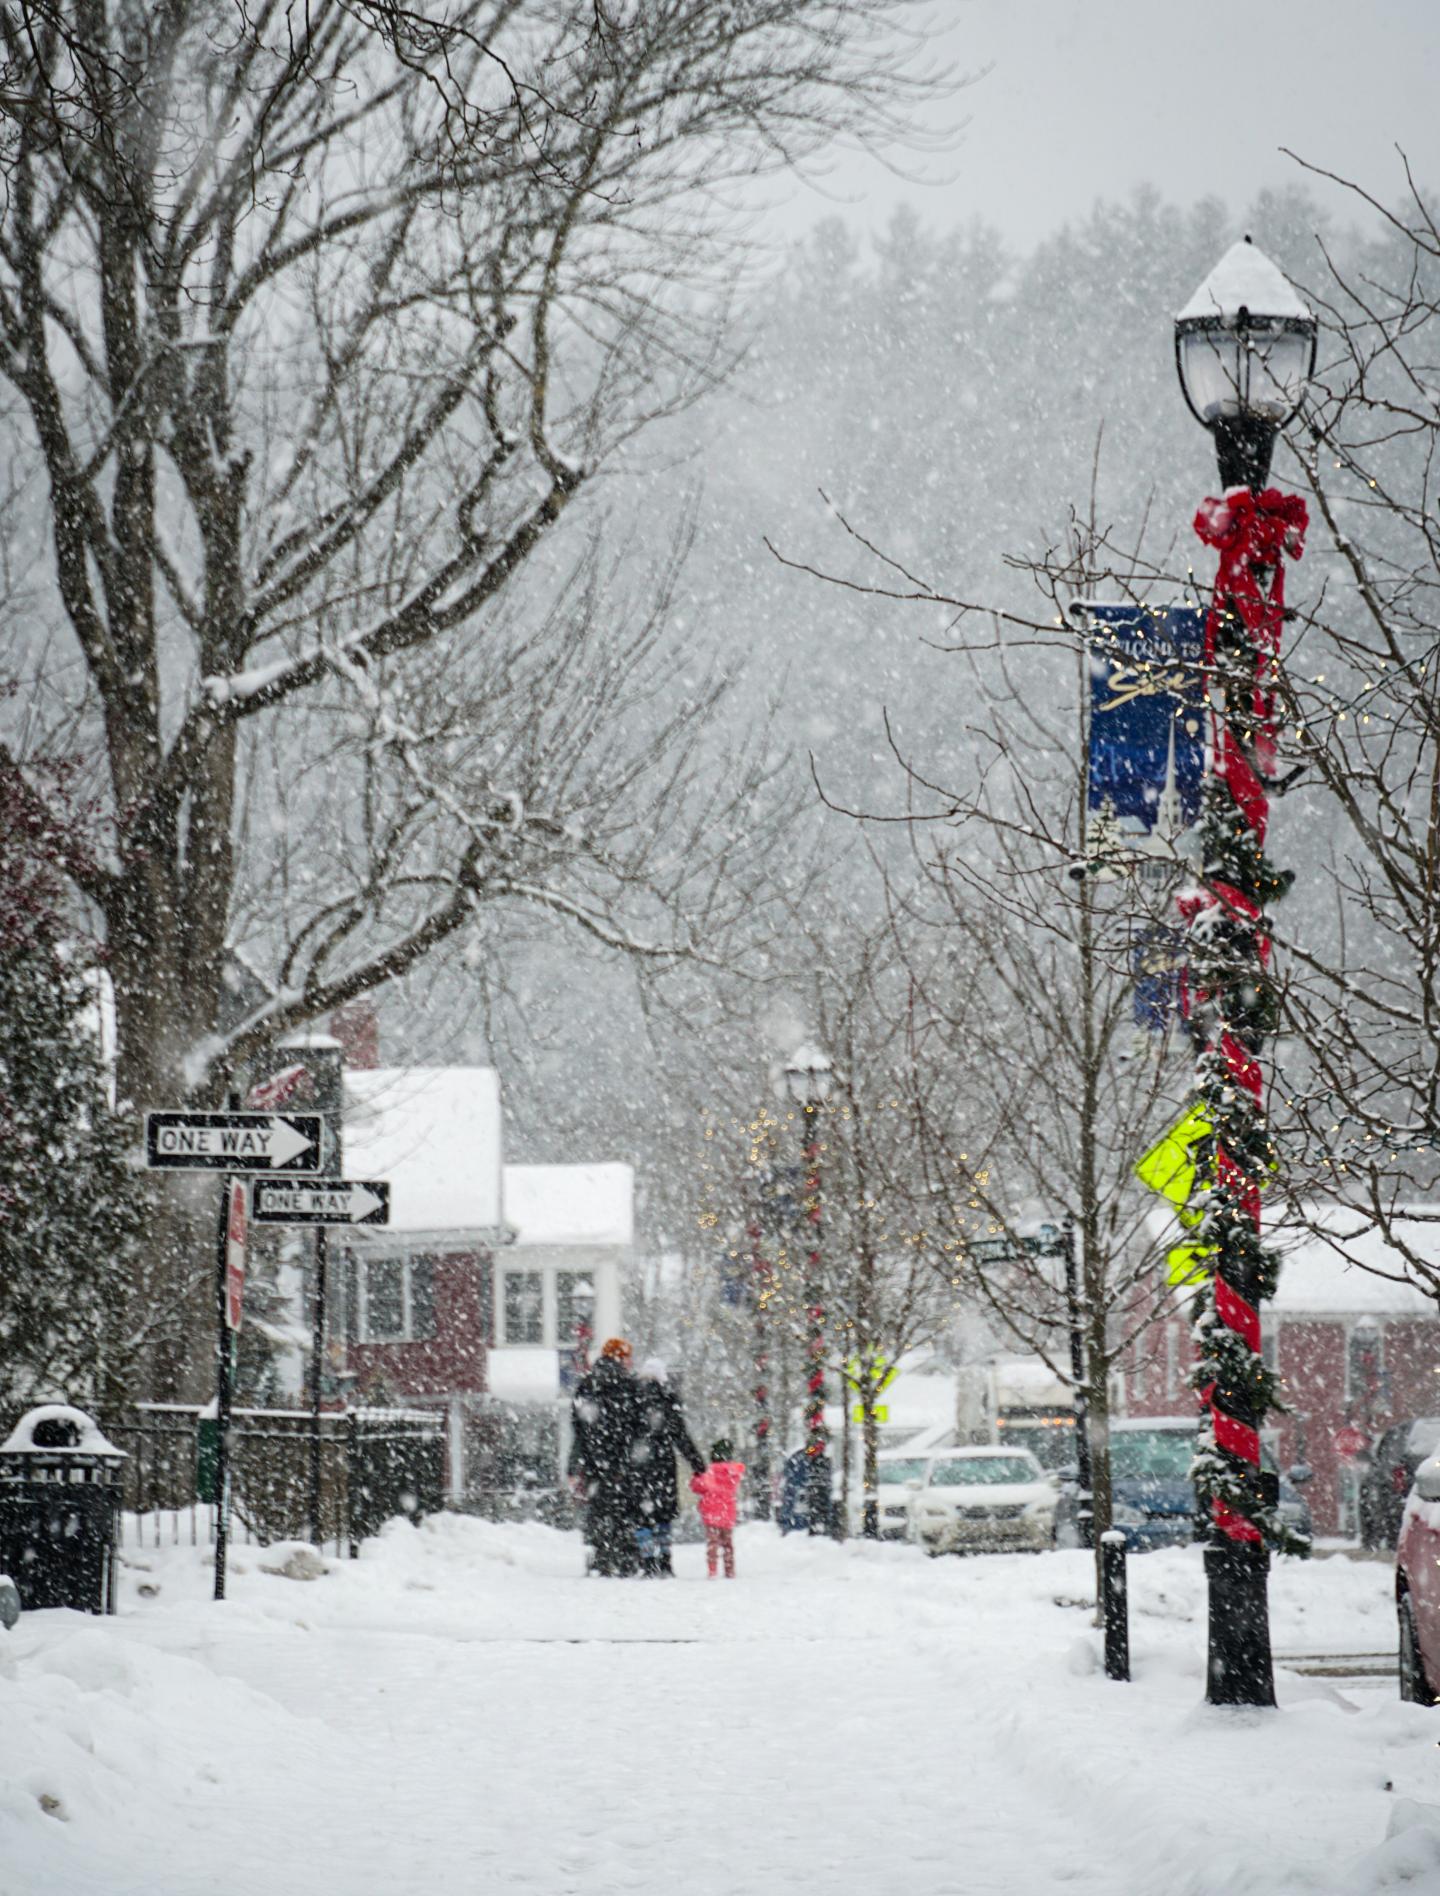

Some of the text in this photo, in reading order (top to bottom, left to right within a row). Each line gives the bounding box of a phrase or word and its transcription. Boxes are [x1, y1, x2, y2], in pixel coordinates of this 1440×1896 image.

[161, 1130, 273, 1152] ONE WAY
[263, 1191, 351, 1211] ONE WAY
